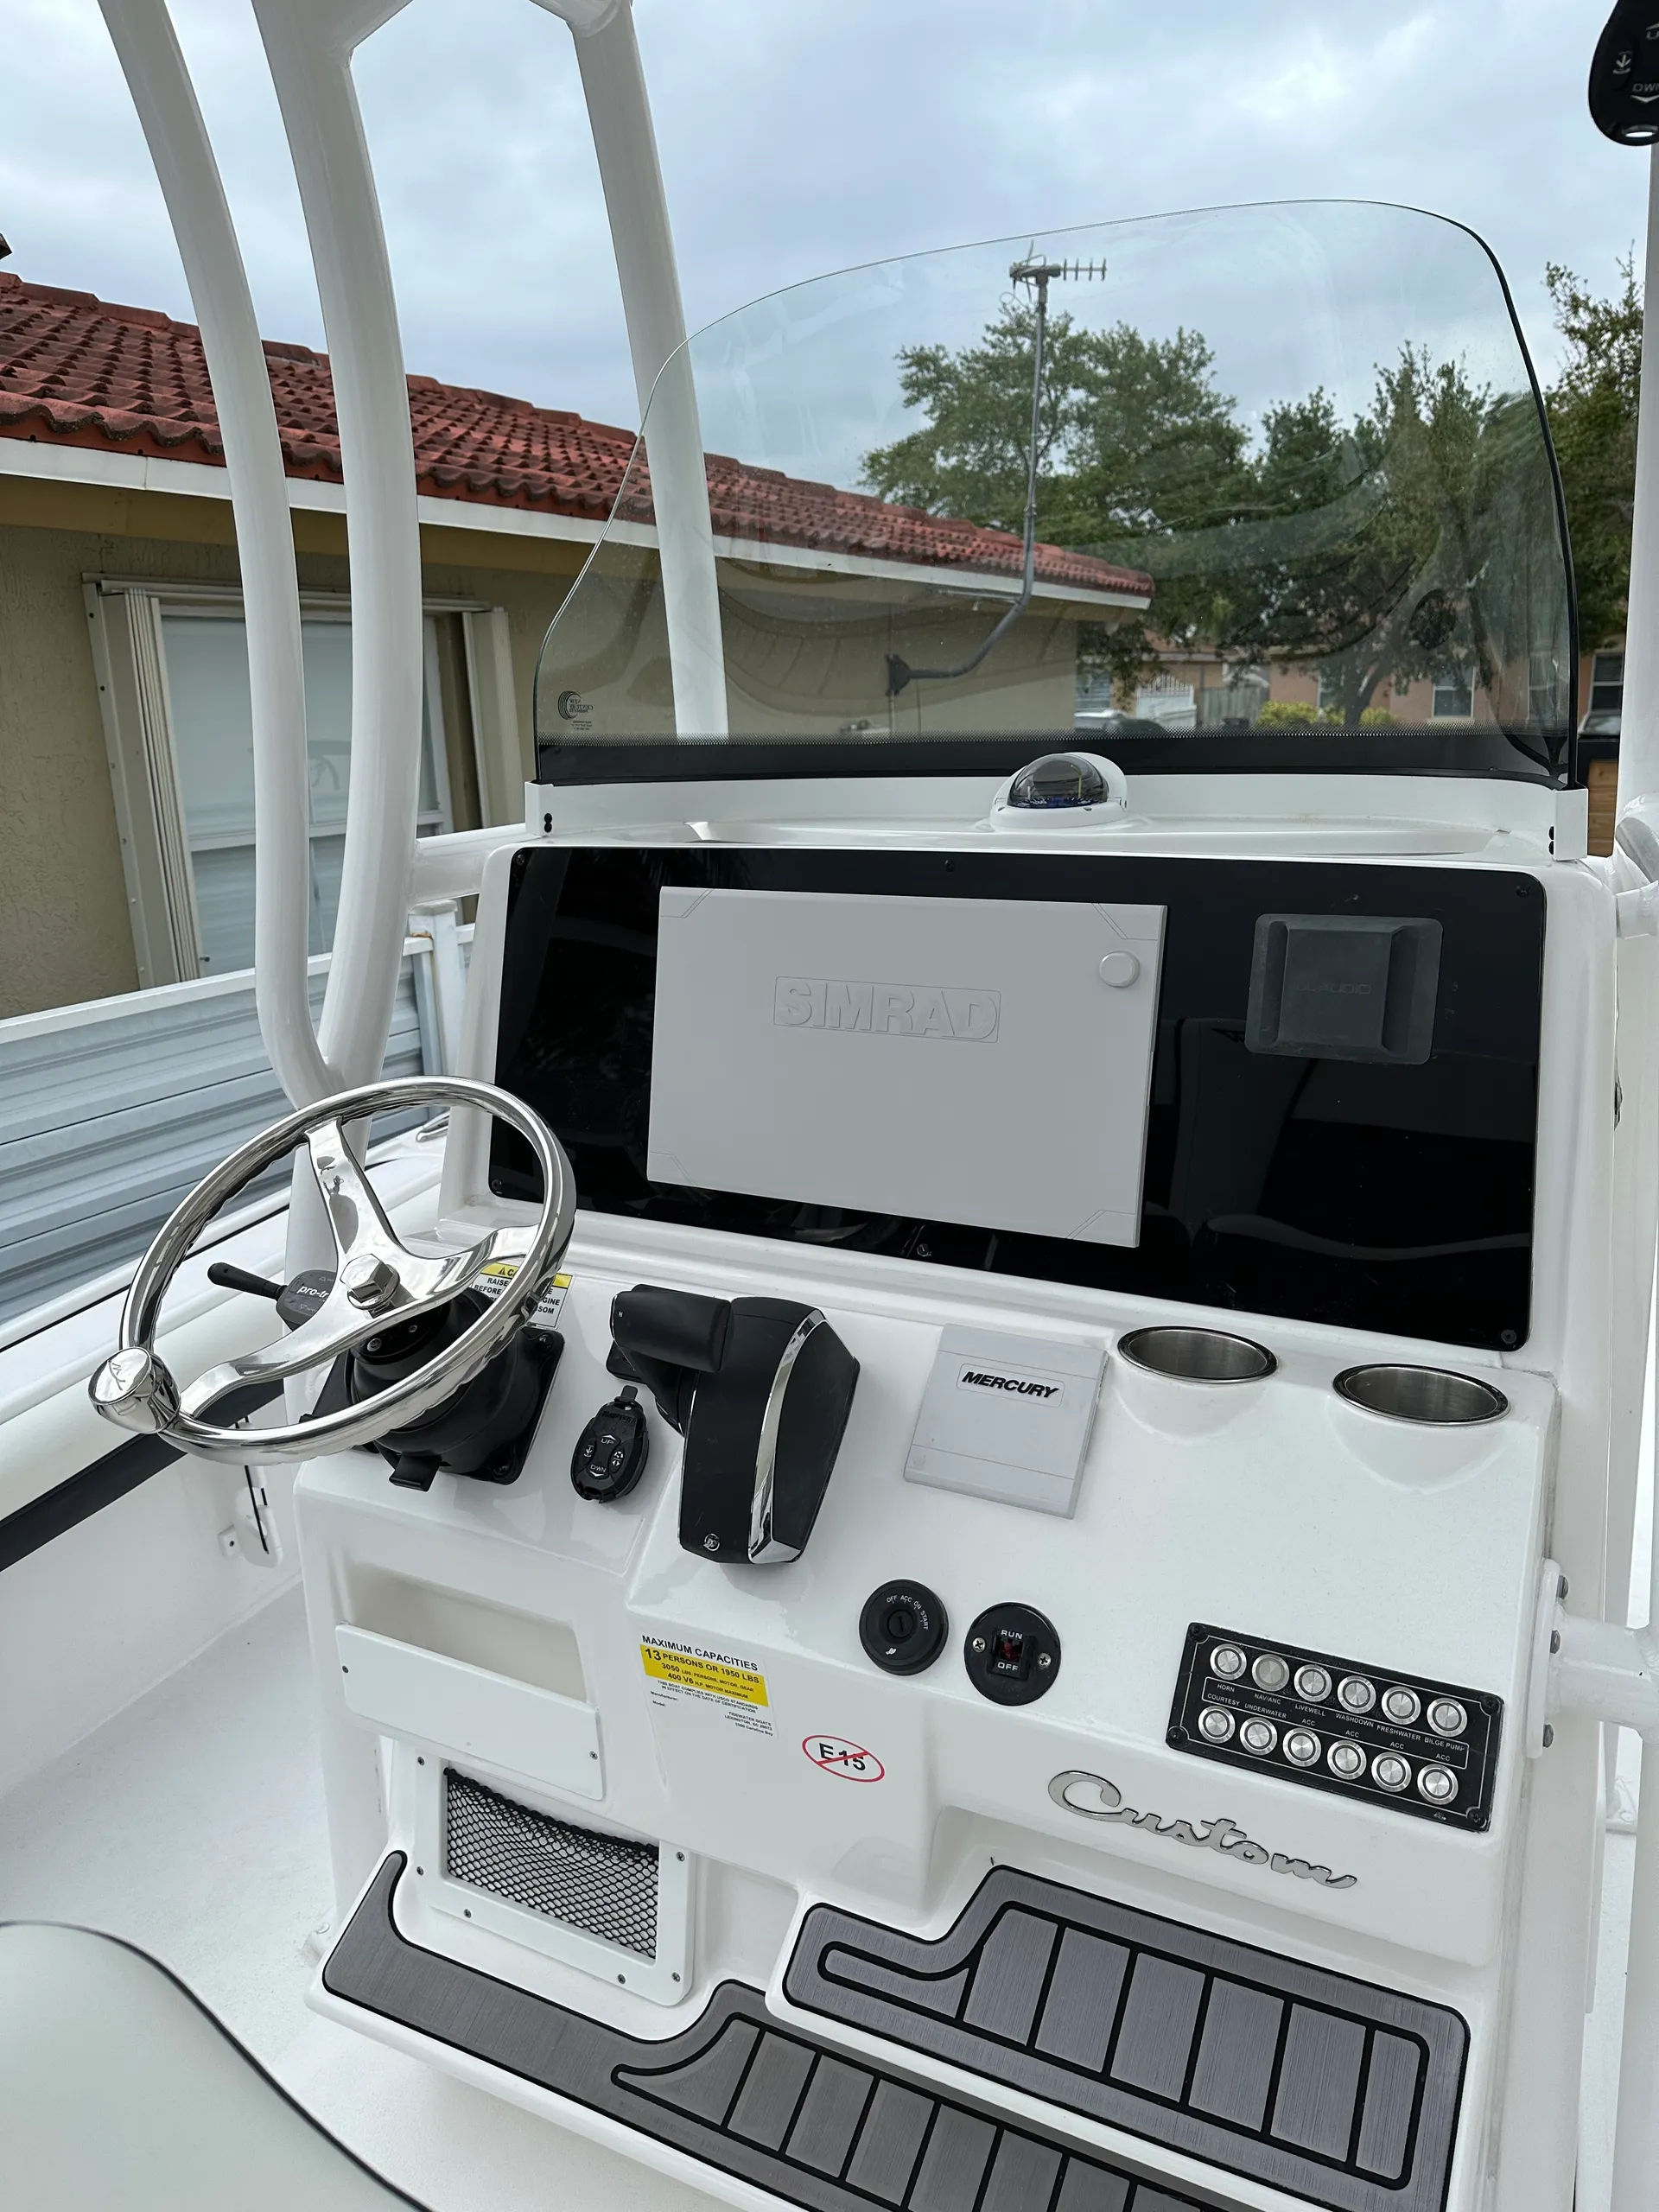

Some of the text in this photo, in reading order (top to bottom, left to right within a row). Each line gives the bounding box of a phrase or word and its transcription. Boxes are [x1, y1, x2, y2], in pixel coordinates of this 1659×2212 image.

[777, 979, 999, 1040] SIMRAD
[487, 1277, 509, 1287] RAISE
[296, 1286, 329, 1298] pro-tr
[962, 1371, 1059, 1398] MERCURY
[590, 1464, 607, 1472] DWN
[913, 1600, 922, 1610] ON
[920, 1610, 929, 1630] START
[1001, 1629, 1023, 1640] RUN
[642, 1635, 759, 1671] MAXIMUM CAPACITIES
[645, 1648, 661, 1661] 13
[663, 1653, 703, 1669] PERSONS
[705, 1664, 719, 1673] OR
[721, 1668, 740, 1679] 1950
[661, 1662, 680, 1673] 3050
[997, 1662, 1020, 1672] OFF
[706, 1684, 724, 1693] MOTOR
[1217, 1683, 1235, 1693] HORN
[1207, 1693, 1240, 1707] COURTESY
[1254, 1693, 1281, 1705] NAV/ANC
[1244, 1703, 1287, 1719] UNDERWATER
[1294, 1704, 1325, 1717] LIVEWELL
[1301, 1718, 1316, 1726] ACC
[1335, 1713, 1374, 1727] WASHDOWN
[1345, 1729, 1359, 1738] ACC
[1376, 1725, 1421, 1741] FRESHWATER
[1389, 1741, 1404, 1750] ACC
[1424, 1738, 1444, 1747] BILGE
[1435, 1753, 1451, 1762] ACC
[1048, 1770, 1357, 1889] Custom
